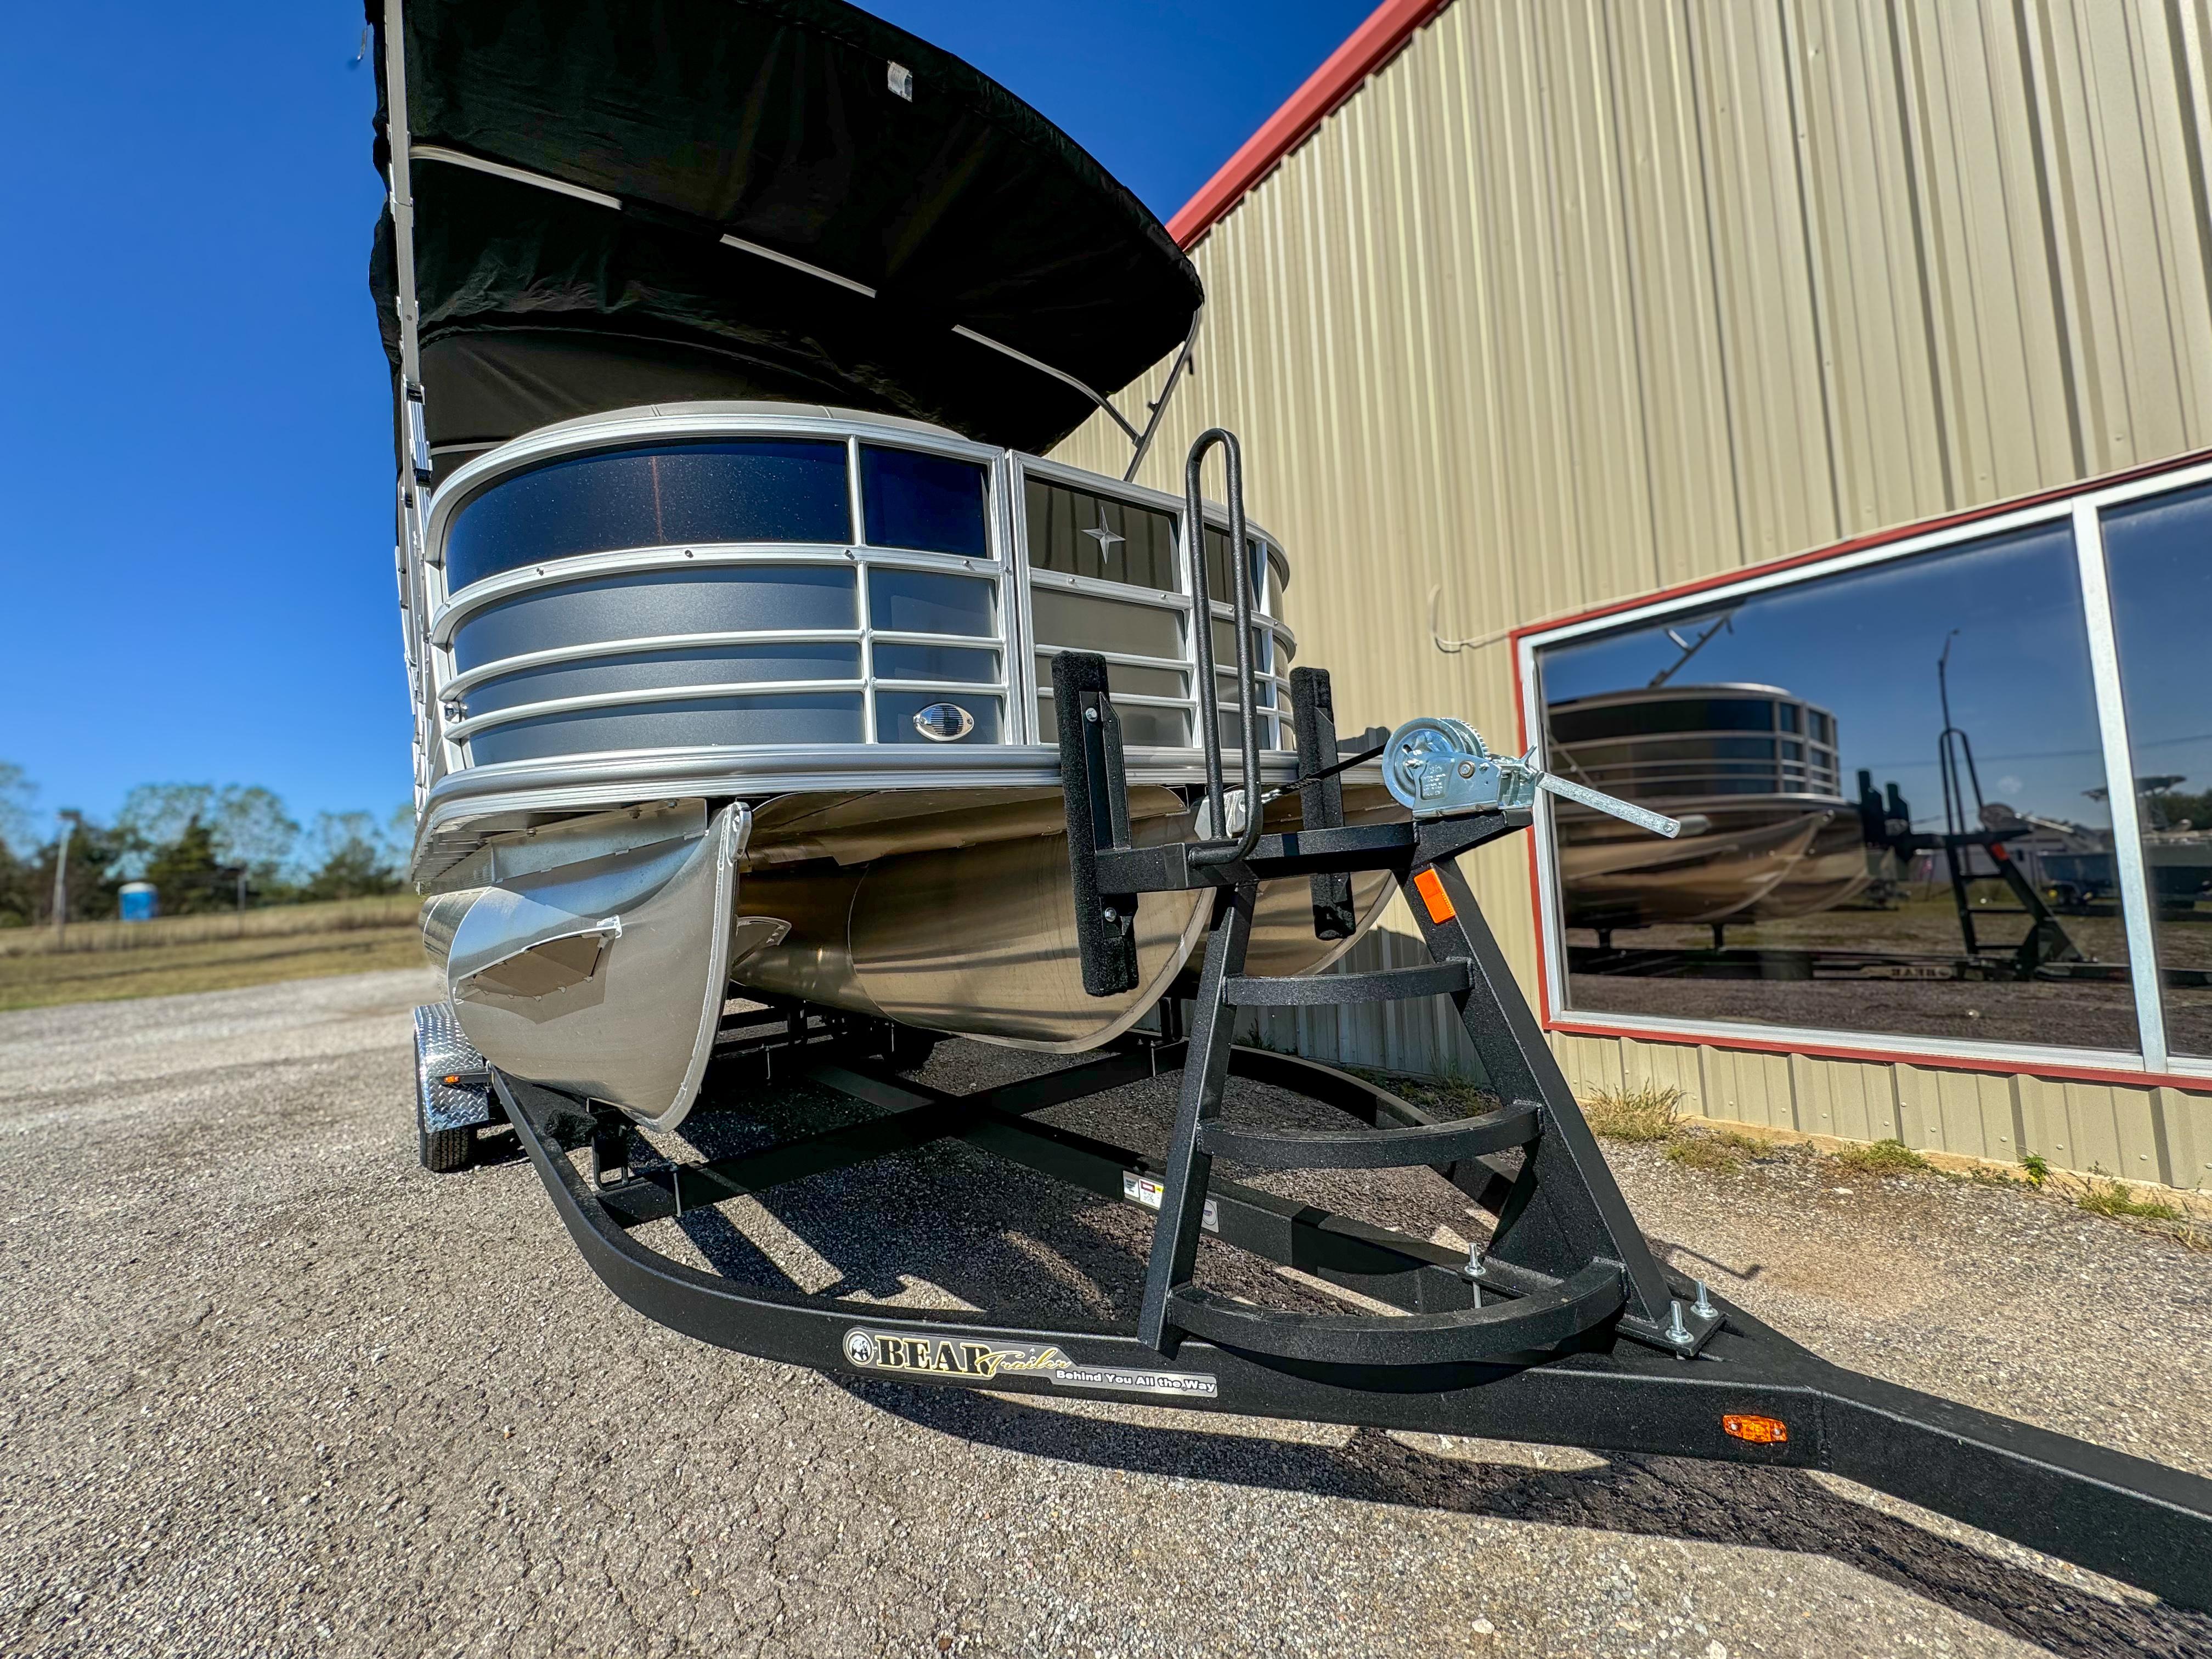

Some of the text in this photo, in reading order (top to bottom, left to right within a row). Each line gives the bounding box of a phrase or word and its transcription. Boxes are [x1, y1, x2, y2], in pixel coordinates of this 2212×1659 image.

[874, 1335, 1072, 1377] BEAR Trailer
[1056, 1370, 1216, 1392] Behind You All the Way
